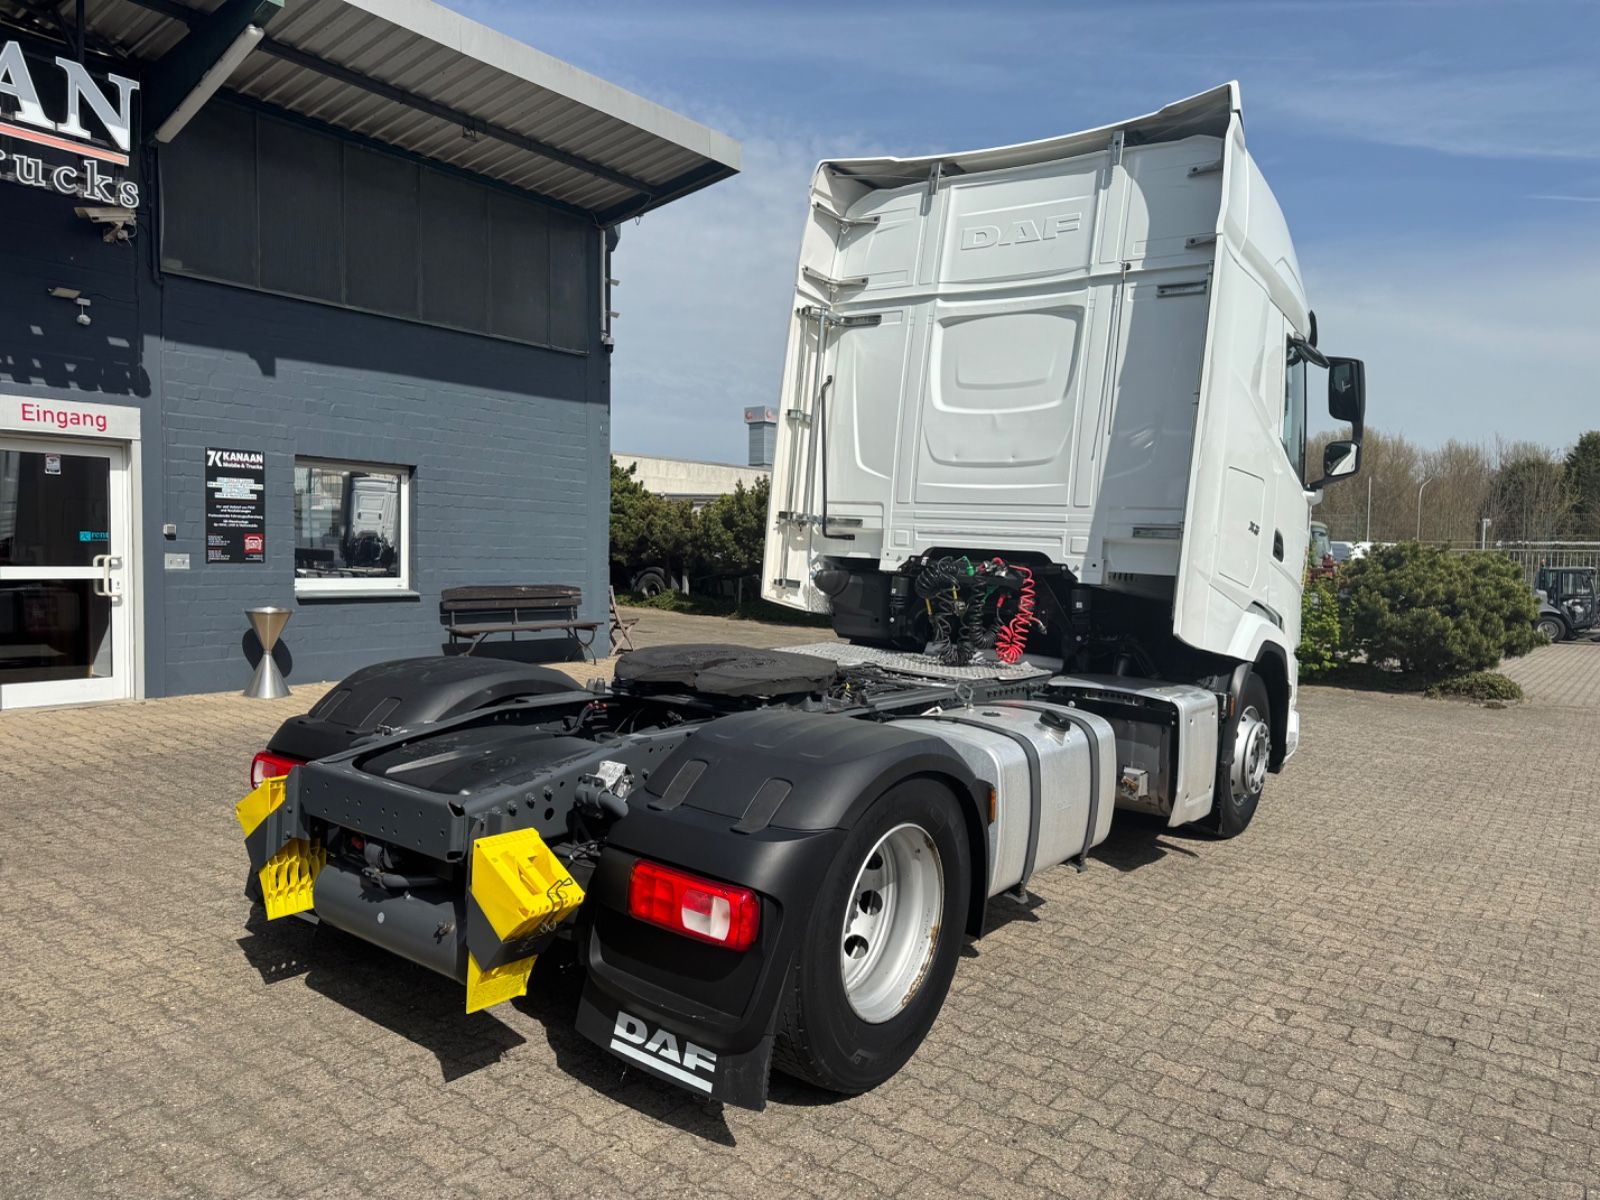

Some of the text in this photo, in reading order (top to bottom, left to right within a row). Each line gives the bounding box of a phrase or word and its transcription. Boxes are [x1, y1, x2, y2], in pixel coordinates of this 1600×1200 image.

[0, 150, 140, 208] ucks
[960, 212, 1082, 251] DAF
[21, 402, 107, 432] Eingang
[613, 1010, 717, 1073] DAF
